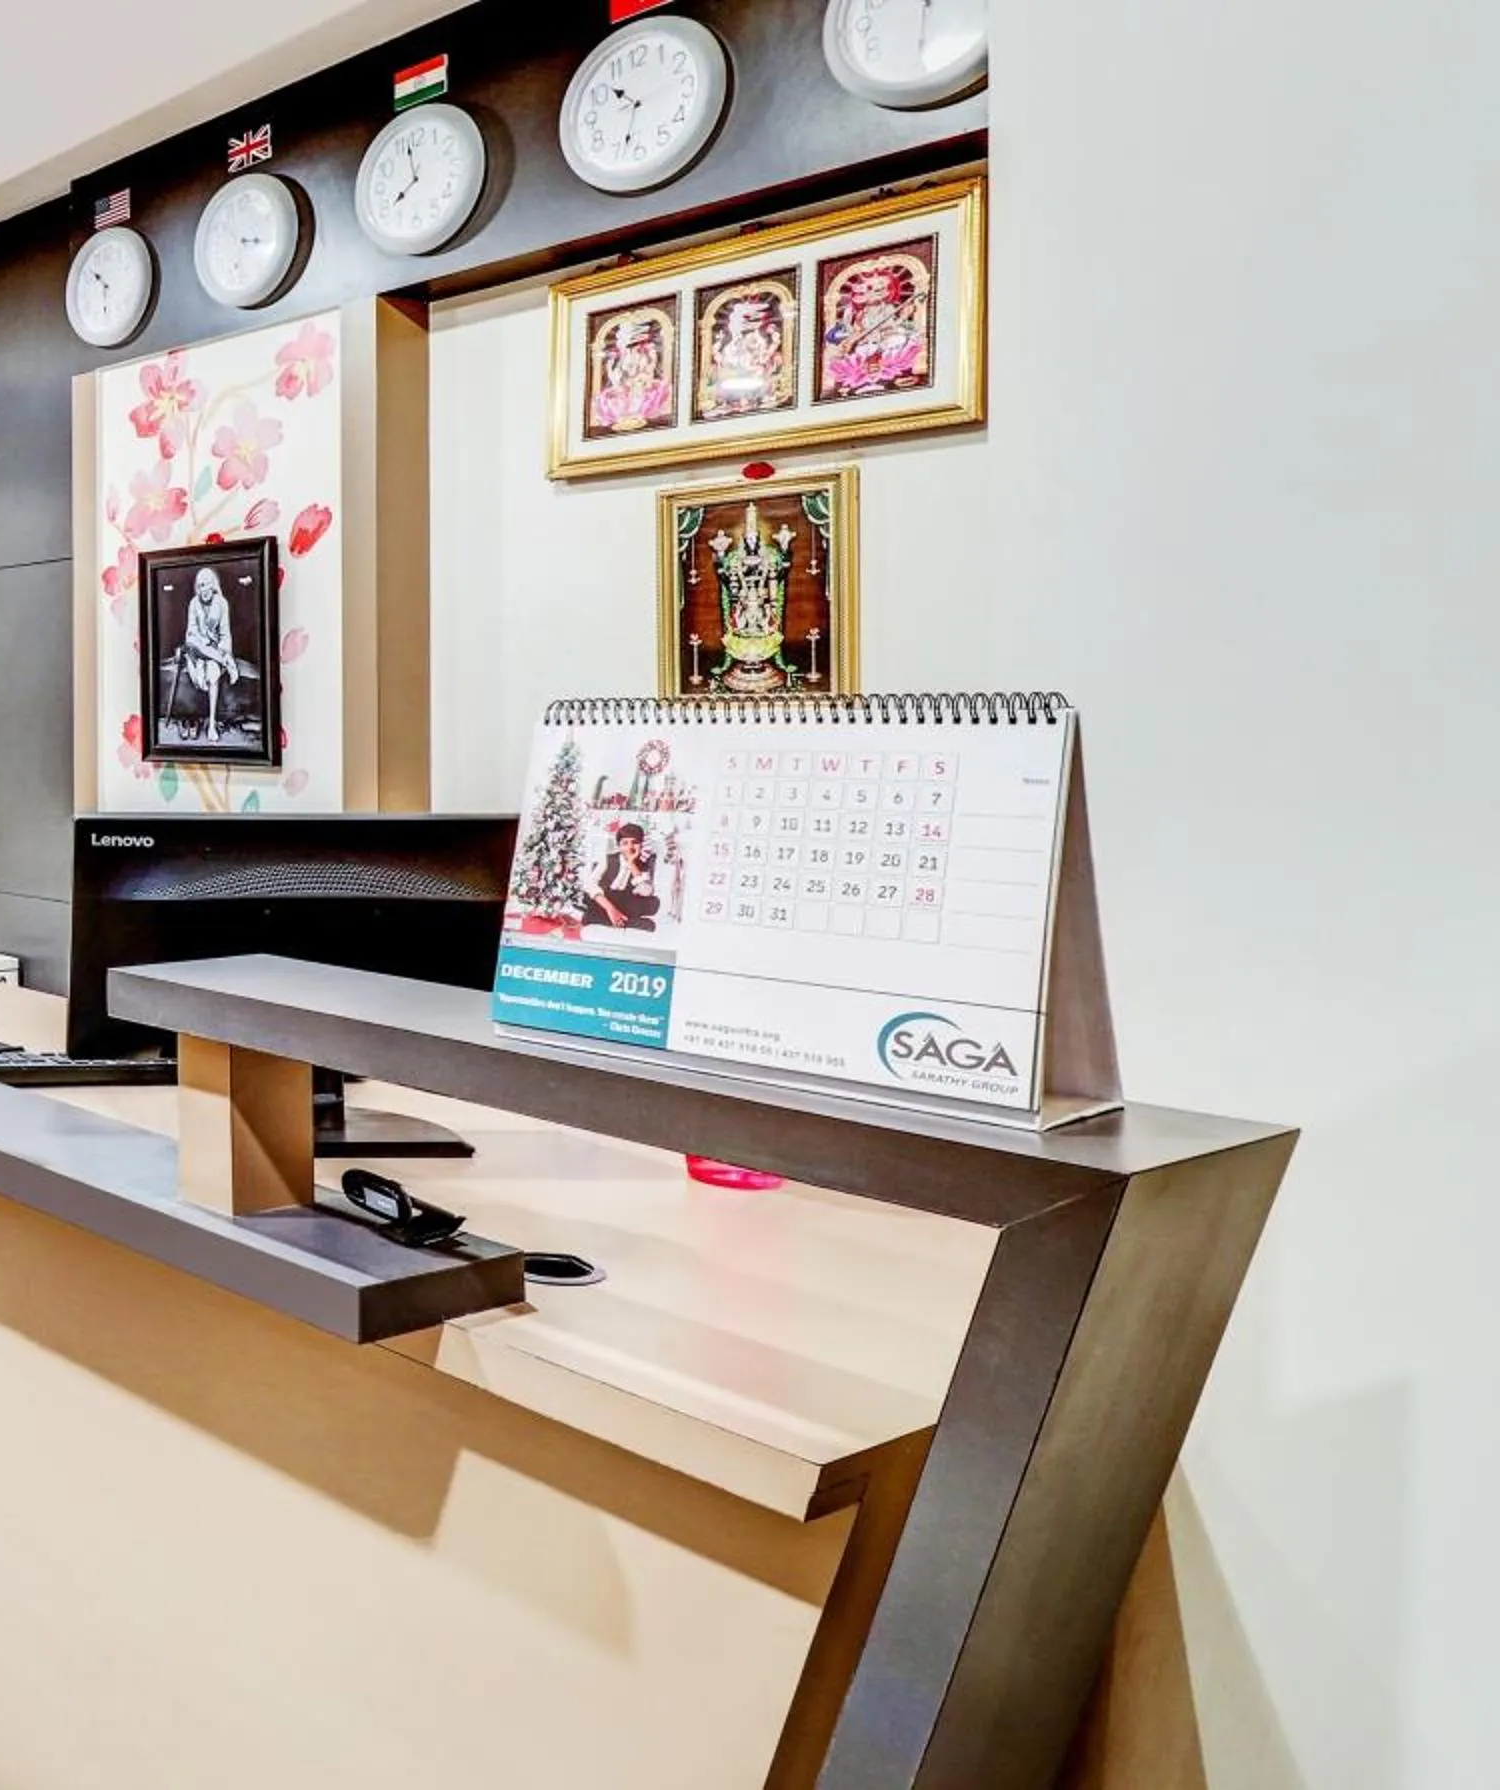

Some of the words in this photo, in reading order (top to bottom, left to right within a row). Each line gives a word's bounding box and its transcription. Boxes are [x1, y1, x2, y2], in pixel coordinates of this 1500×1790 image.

[630, 44, 648, 69] 12
[673, 51, 687, 75] 2
[611, 57, 623, 80] 11
[591, 83, 609, 107] 10
[681, 74, 695, 99] 3
[584, 111, 597, 129] 9
[671, 104, 685, 123] 4
[657, 124, 671, 146] 5
[728, 757, 737, 769] S
[755, 758, 773, 770] M
[791, 757, 803, 770] T
[822, 760, 840, 772] W
[861, 760, 872, 773] T
[897, 760, 909, 773] F
[935, 762, 945, 775] S
[726, 786, 732, 799] 1
[755, 788, 765, 799] 2
[788, 788, 798, 801] 3
[822, 789, 831, 801] 4
[856, 790, 867, 804] 5
[893, 791, 904, 804] 6
[932, 793, 942, 805] 7
[752, 816, 762, 829] 9
[781, 818, 798, 831] 10
[814, 820, 831, 833] 11
[849, 821, 868, 834] 12
[885, 823, 905, 836] 13
[922, 824, 941, 838] 14
[90, 832, 155, 848] Lenovo
[713, 844, 729, 857] 15
[744, 846, 761, 858] 16
[777, 848, 795, 860] 17
[811, 850, 829, 863] 18
[845, 852, 865, 865] 19
[880, 854, 901, 868] 20
[918, 856, 937, 871] 21
[708, 873, 726, 885] 22
[740, 876, 758, 889] 23
[773, 878, 791, 890] 24
[806, 880, 826, 894] 25
[841, 882, 861, 897] 26
[877, 886, 898, 899] 27
[915, 889, 935, 903] 28
[705, 902, 723, 915] 29
[737, 904, 755, 918] 30
[771, 908, 787, 921] 31
[501, 963, 593, 989] DECEMBER
[608, 970, 667, 999] 2019
[892, 1031, 1018, 1077] SAGA
[971, 1080, 1020, 1096] GROUP
